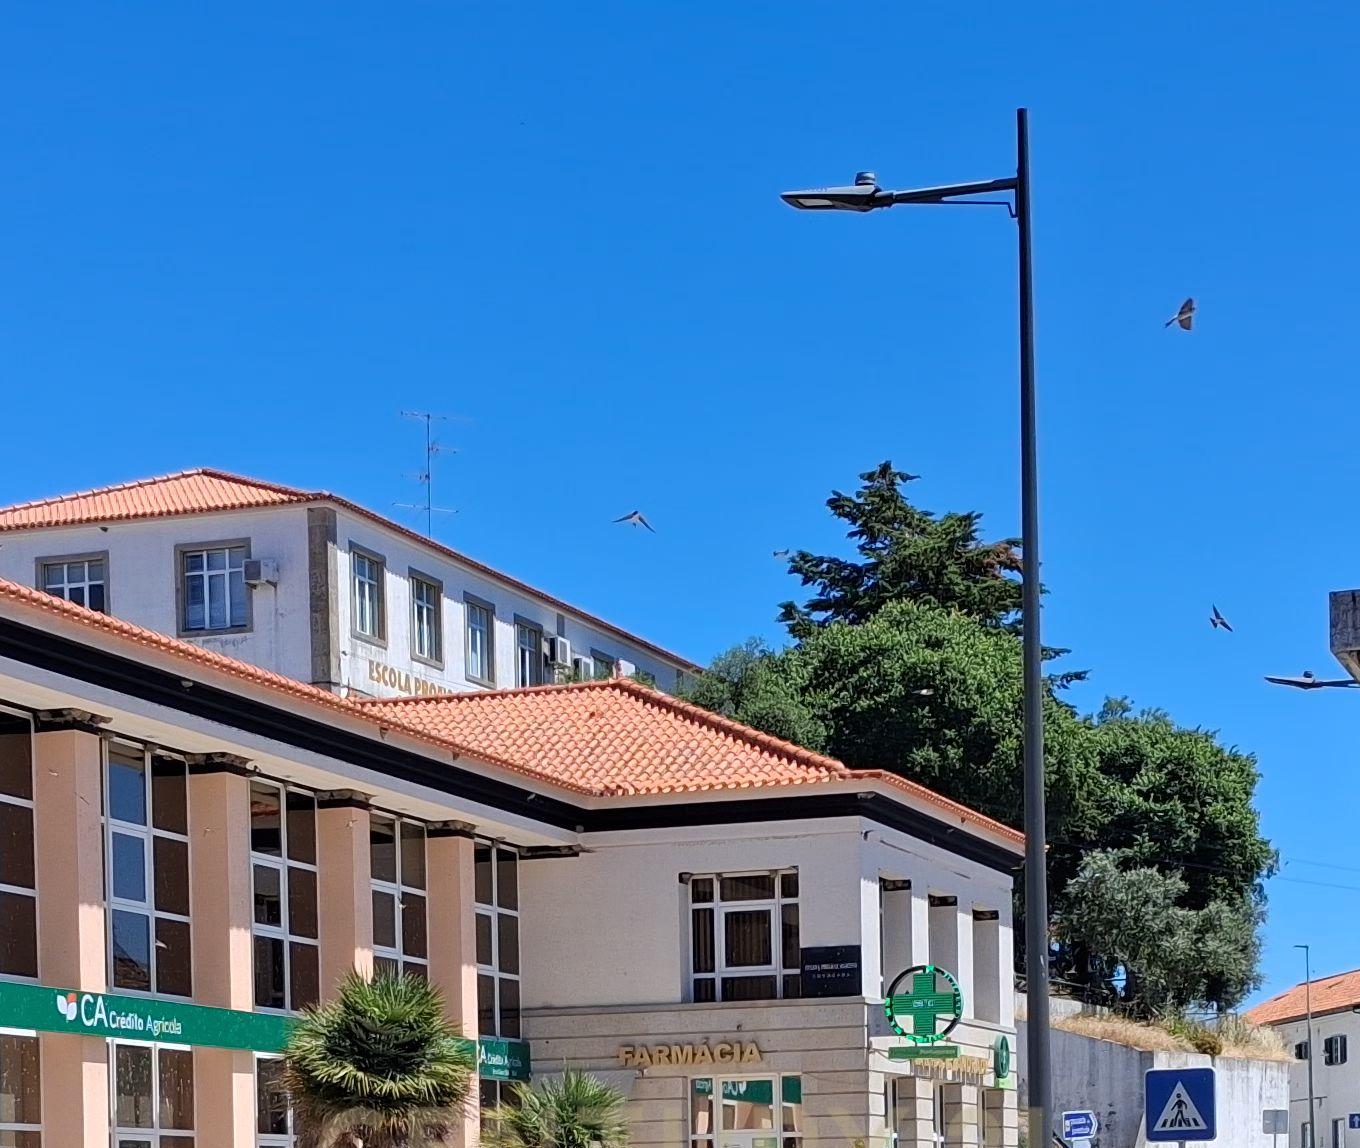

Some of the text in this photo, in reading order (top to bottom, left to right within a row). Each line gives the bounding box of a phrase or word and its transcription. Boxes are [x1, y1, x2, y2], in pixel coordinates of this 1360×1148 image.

[368, 659, 412, 695] ESCOLA
[81, 993, 182, 1036] CA Crédito Agrícola
[618, 1038, 762, 1067] FARMÁCIA
